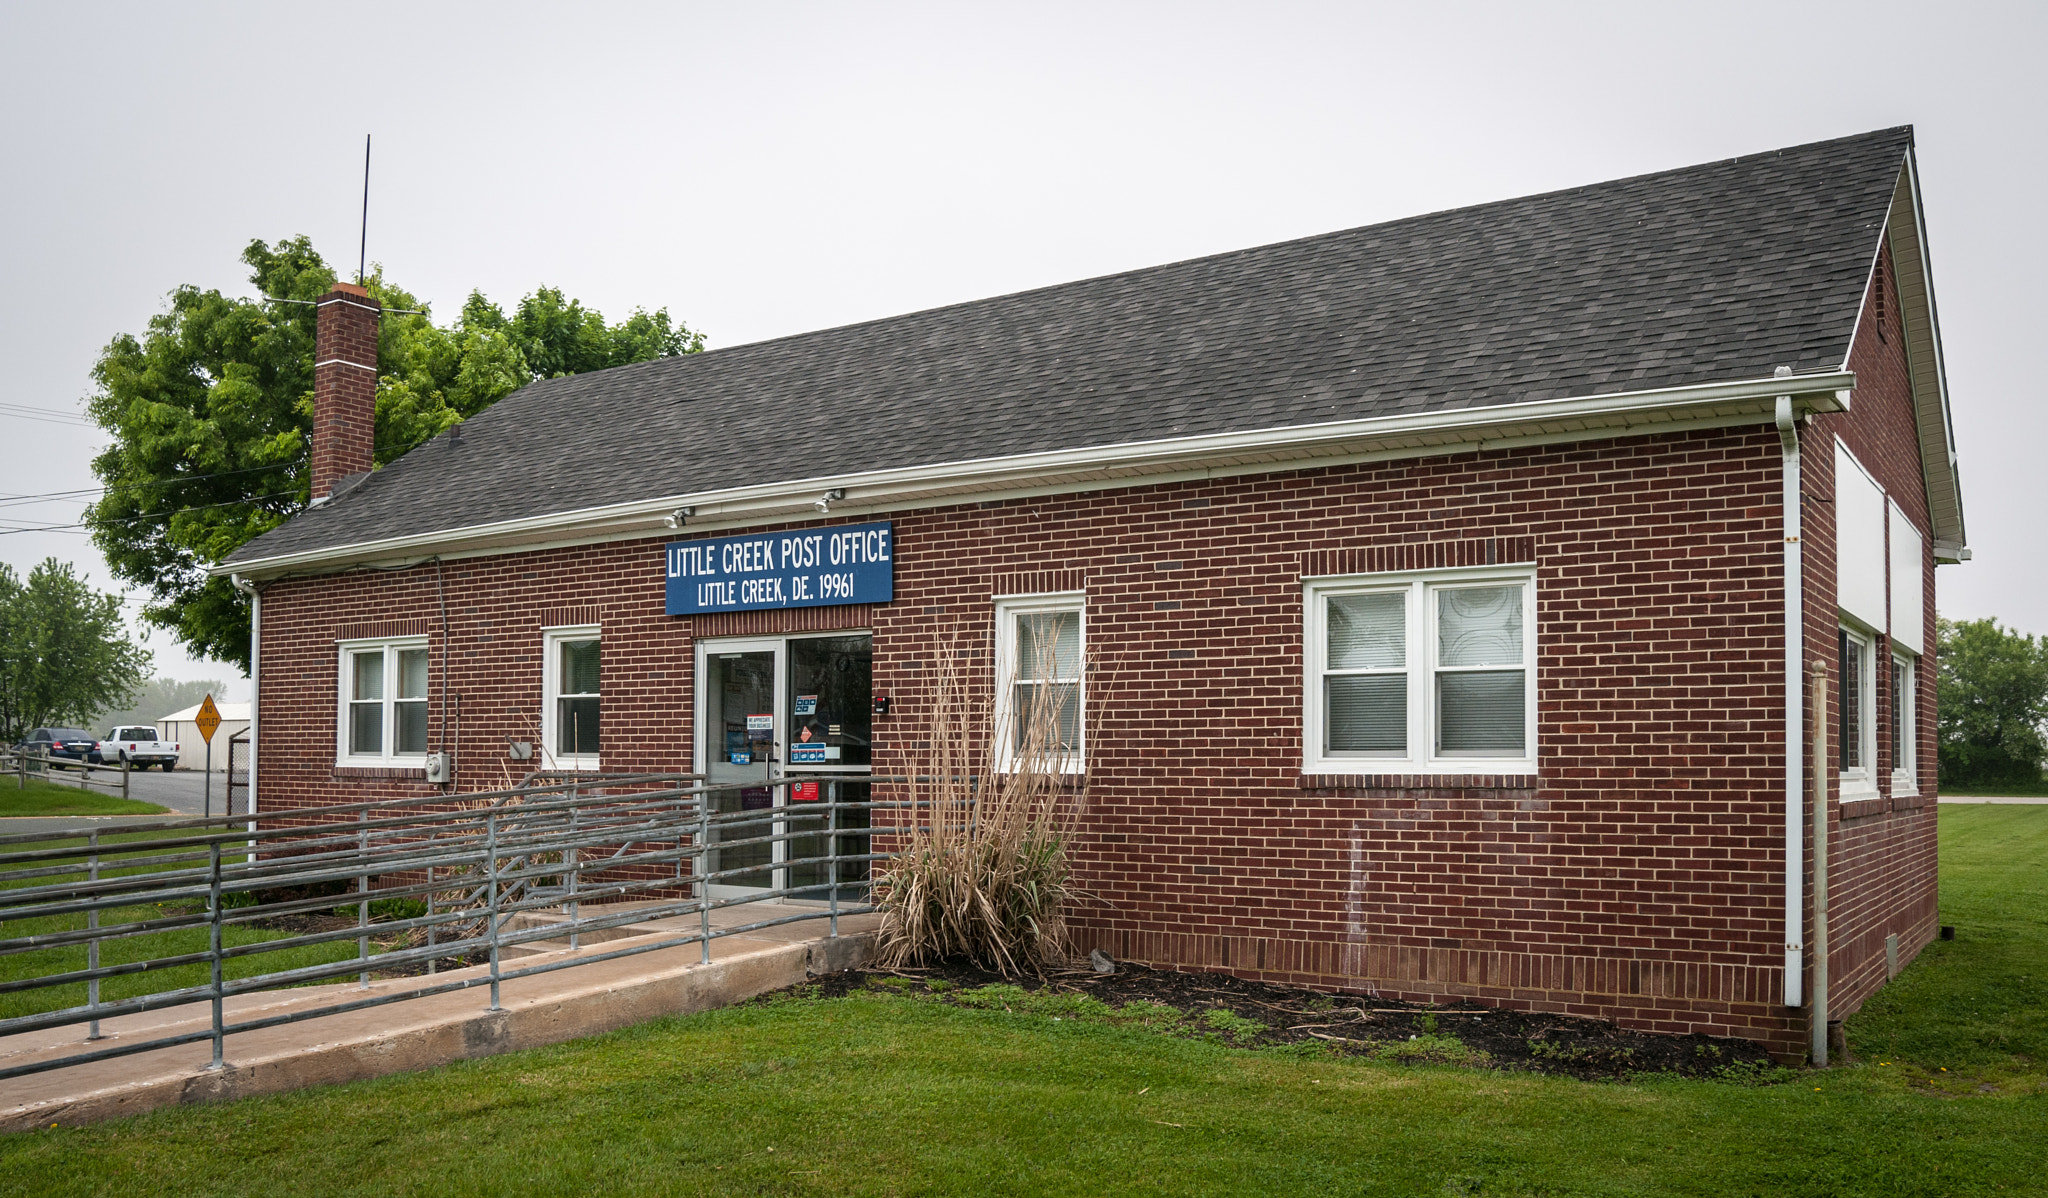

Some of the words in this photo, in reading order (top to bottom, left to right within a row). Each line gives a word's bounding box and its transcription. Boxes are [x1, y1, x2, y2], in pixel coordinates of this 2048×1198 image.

[668, 545, 715, 578] LITTLE
[722, 540, 774, 574] CREEK
[781, 536, 823, 569] POST
[830, 529, 889, 566] OFFICE
[698, 581, 736, 607] LITTLE
[741, 578, 787, 606] CREEK,
[792, 576, 814, 601] DE.
[819, 573, 854, 599] 19961
[204, 705, 213, 714] NO
[198, 717, 218, 727] OUTLET
